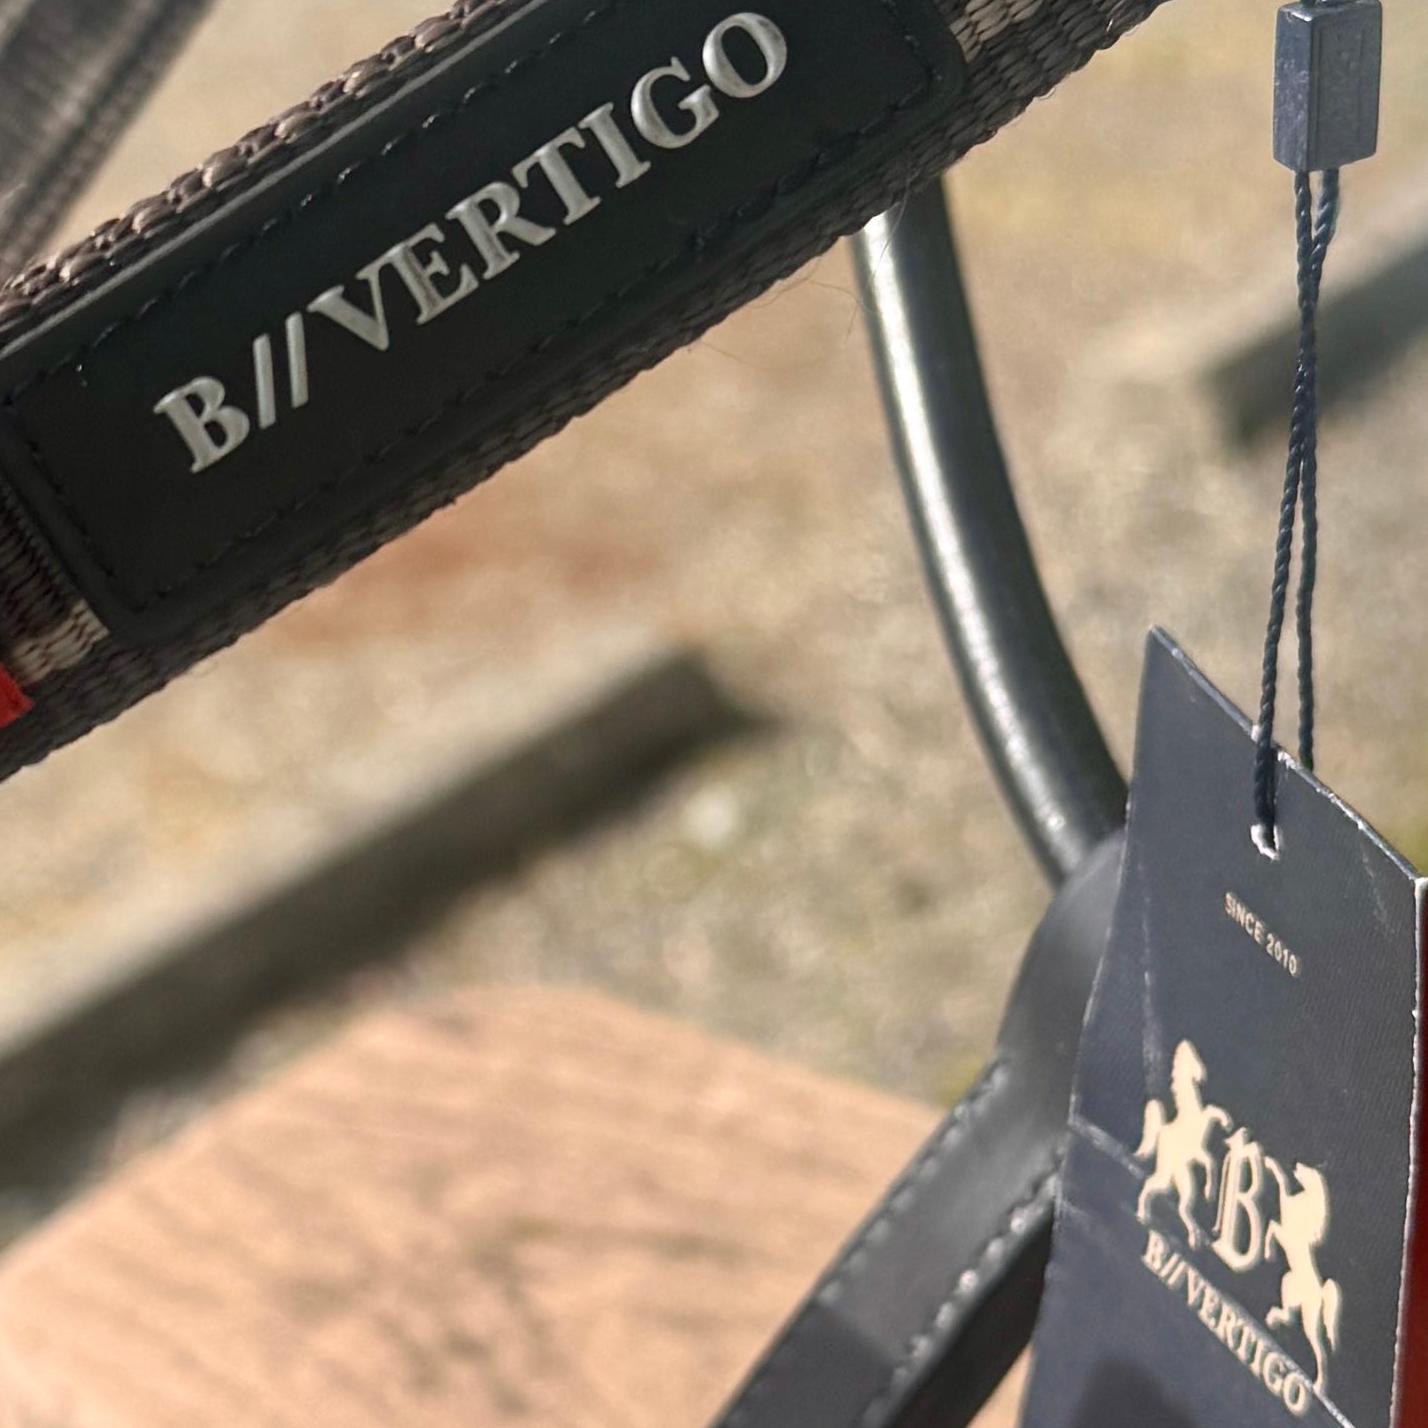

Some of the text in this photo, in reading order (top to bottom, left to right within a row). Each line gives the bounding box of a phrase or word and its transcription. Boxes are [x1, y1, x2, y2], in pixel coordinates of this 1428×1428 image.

[153, 11, 788, 473] B//VERTIGO
[1224, 891, 1298, 977] SINCE 2010
